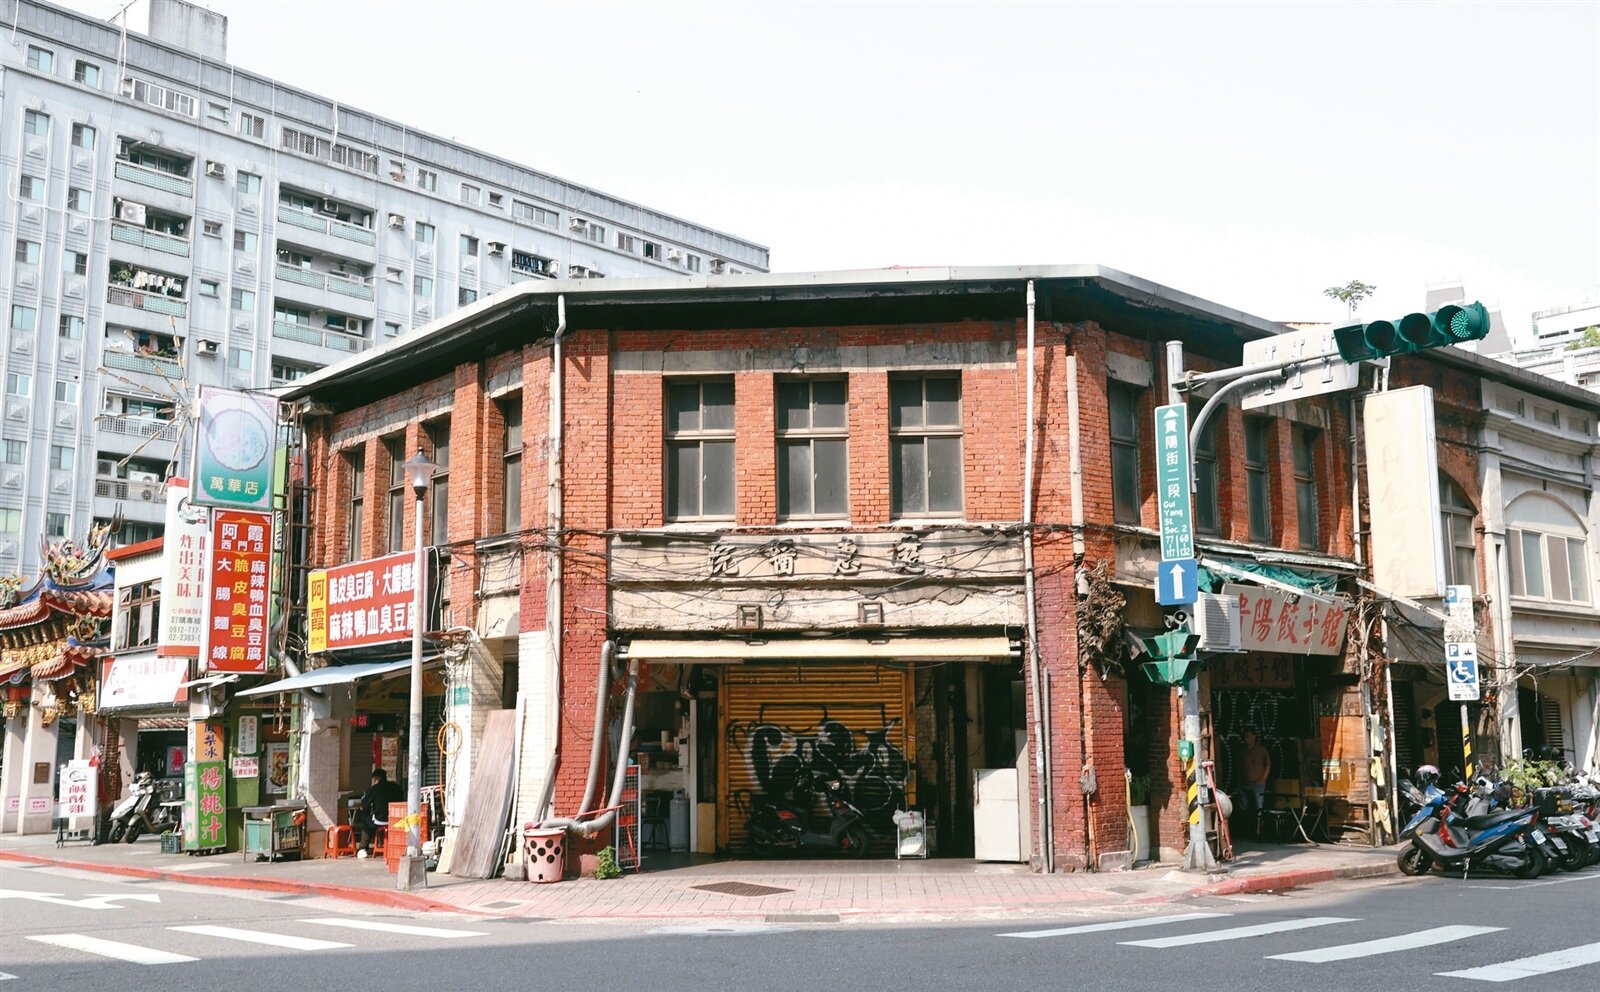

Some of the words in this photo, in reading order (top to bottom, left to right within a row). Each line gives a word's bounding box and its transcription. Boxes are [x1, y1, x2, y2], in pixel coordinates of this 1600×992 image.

[1165, 419, 1181, 498] 貴陽街二段
[209, 475, 259, 495] 萬華店
[1163, 500, 1176, 508] Gui
[1163, 510, 1184, 518] Yang
[221, 523, 264, 542] 阿霞
[1179, 534, 1190, 543] 68
[1181, 524, 1188, 533] 2
[220, 539, 264, 553] 西門店
[176, 534, 194, 598] 炸出美味
[212, 557, 232, 660] 大腸麵線
[229, 558, 249, 661] 脆皮臭豆腐
[246, 560, 266, 661] 麻辣鴨血臭豆腐
[311, 578, 325, 631] 阿霞
[1450, 645, 1458, 656] P
[204, 721, 218, 758] 鳳梨冰
[201, 766, 223, 842] 楊桃汁
